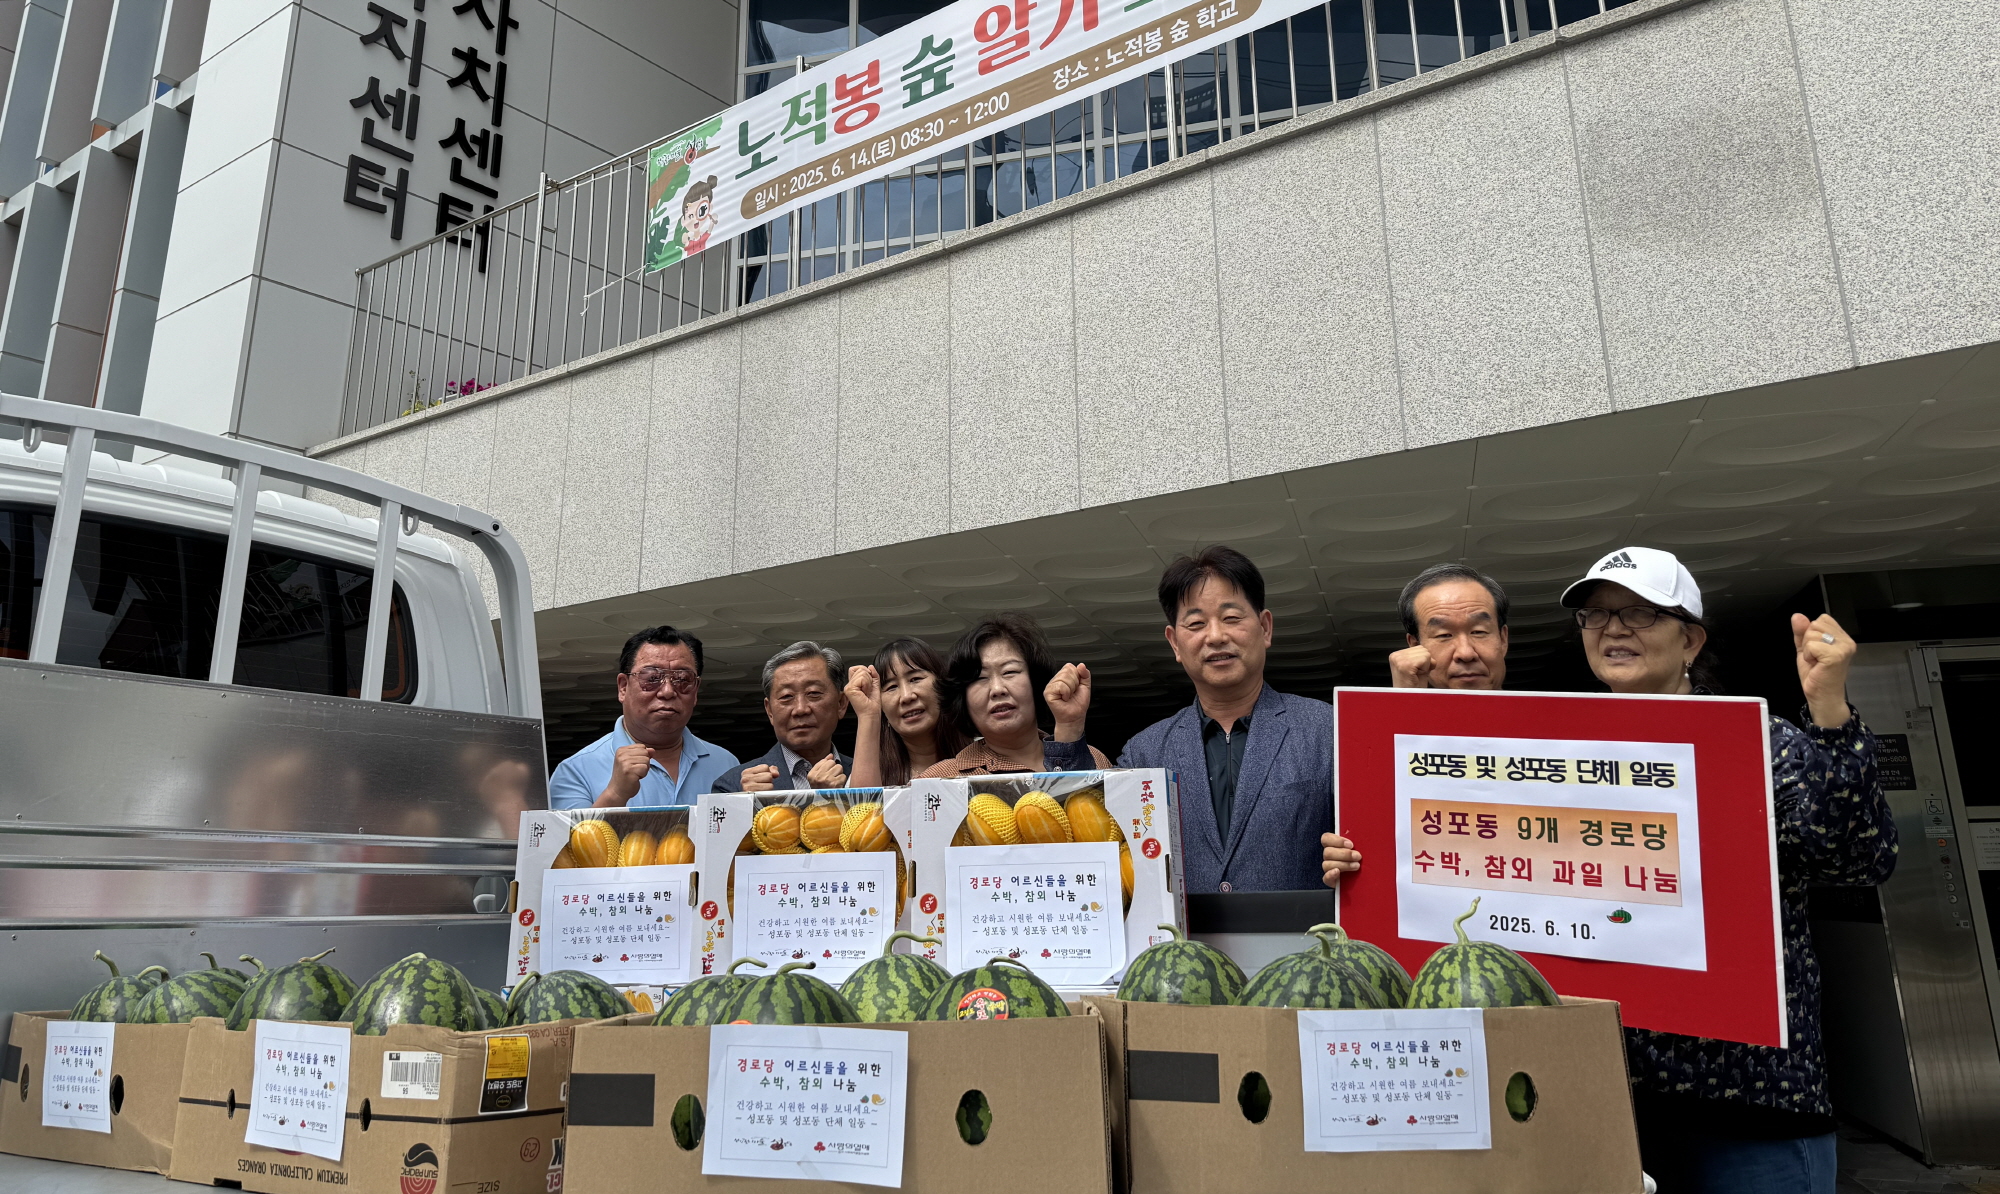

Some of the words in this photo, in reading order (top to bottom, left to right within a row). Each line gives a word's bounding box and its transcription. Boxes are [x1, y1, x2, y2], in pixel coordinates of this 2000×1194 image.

[1052, 60, 1089, 90] 장소
[1105, 27, 1163, 68] 노적봉
[1170, 20, 1190, 43] 숲
[1197, 0, 1239, 28] 학교
[735, 59, 883, 179] 노적봉
[901, 35, 956, 108] 숲
[344, 0, 426, 240] 지센터
[754, 184, 778, 211] 일시
[790, 166, 828, 195] 2025.
[831, 159, 845, 177] 6.
[900, 122, 944, 151] 08:30
[964, 92, 1010, 126] 12:00
[1600, 561, 1637, 572] adidas
[1409, 752, 1467, 777] 성포동
[1475, 755, 1496, 779] 및
[1505, 757, 1567, 783] 성포동
[1576, 760, 1620, 785] 단체
[1629, 761, 1676, 788] 일동
[1420, 810, 1498, 839] 성포동
[1517, 816, 1559, 843] 9개
[1579, 819, 1667, 850] 경로당
[1414, 850, 1470, 877] 수박,
[1484, 855, 1533, 881] 참외
[1552, 860, 1603, 888] 과일
[1624, 865, 1678, 893] 나눔
[757, 883, 790, 896] 경로당
[797, 882, 850, 894] 어르신들을
[857, 881, 876, 892] 위한
[969, 876, 1003, 890] 경로당
[1010, 874, 1067, 888] 어르신들을
[1075, 874, 1097, 887] 위한
[561, 895, 590, 905] 경로당
[597, 892, 646, 904] 어르신들을
[652, 891, 672, 902] 위한
[810, 896, 830, 907] 참외
[839, 896, 858, 907] 나눔
[1025, 890, 1046, 902] 참외
[1055, 890, 1077, 902] 나눔
[608, 905, 627, 916] 참외
[634, 905, 653, 915] 나눔
[758, 918, 790, 927] 건강하고
[794, 918, 817, 927] 시원한
[821, 918, 835, 926] 여름
[972, 914, 1005, 924] 건강하고
[1009, 913, 1033, 923] 시원한
[1038, 913, 1053, 922] 여름
[561, 925, 590, 935] 건강하고
[594, 925, 615, 933] 시원한
[618, 924, 632, 933] 여름
[768, 929, 791, 939] 성포동
[796, 929, 803, 938] 및
[806, 929, 830, 938] 성포동
[833, 929, 848, 937] 단체
[851, 928, 865, 937] 일동
[982, 926, 1007, 936] 성포동
[1011, 926, 1019, 936] 및
[1023, 926, 1047, 936] 성포동
[1051, 926, 1068, 935] 단체
[1072, 925, 1089, 934] 일동
[1489, 914, 1536, 933] 2025.
[1545, 921, 1559, 936] 6.
[1570, 923, 1596, 940] 10.
[570, 935, 591, 944] 성포동
[595, 935, 602, 944] 및
[605, 935, 626, 943] 성포동
[630, 934, 644, 943] 단체
[647, 934, 661, 942] 일동
[1327, 1042, 1362, 1055] 경로당
[1370, 1040, 1430, 1053] 어르신들을
[1439, 1039, 1462, 1052] 위한
[267, 1049, 283, 1061] 경로당
[287, 1051, 318, 1065] 어르신들을
[323, 1055, 336, 1067] 위한
[1386, 1056, 1409, 1069] 참외
[1418, 1056, 1440, 1068] 나눔
[294, 1066, 305, 1077] 참외
[310, 1068, 322, 1079] 나눔
[737, 1058, 775, 1073] 경로당
[784, 1059, 848, 1075] 어르신들을
[857, 1062, 881, 1077] 위한
[506, 1080, 523, 1089] 고당도
[799, 1077, 822, 1090] 참외
[833, 1078, 857, 1092] 나눔
[1331, 1081, 1365, 1091] 건강하고
[1370, 1081, 1395, 1090] 시원한
[1399, 1080, 1417, 1089] 여름
[1342, 1093, 1368, 1104] 성포동
[1372, 1093, 1380, 1103] 및
[1384, 1092, 1410, 1102] 성포동
[1415, 1092, 1431, 1101] 단체
[1436, 1091, 1452, 1100] 일동
[736, 1100, 773, 1111] 건강하고
[778, 1102, 806, 1113] 시원한
[811, 1103, 829, 1114] 여름
[747, 1114, 774, 1125] 성포동
[779, 1116, 788, 1126] 및
[793, 1116, 820, 1126] 성포동
[825, 1117, 843, 1128] 단체
[848, 1117, 866, 1129] 일동
[237, 1158, 266, 1174] ORANGES
[270, 1162, 313, 1181] CALIFORNIA
[317, 1169, 348, 1185] PREMIUM
[477, 1180, 501, 1194] SIZE
